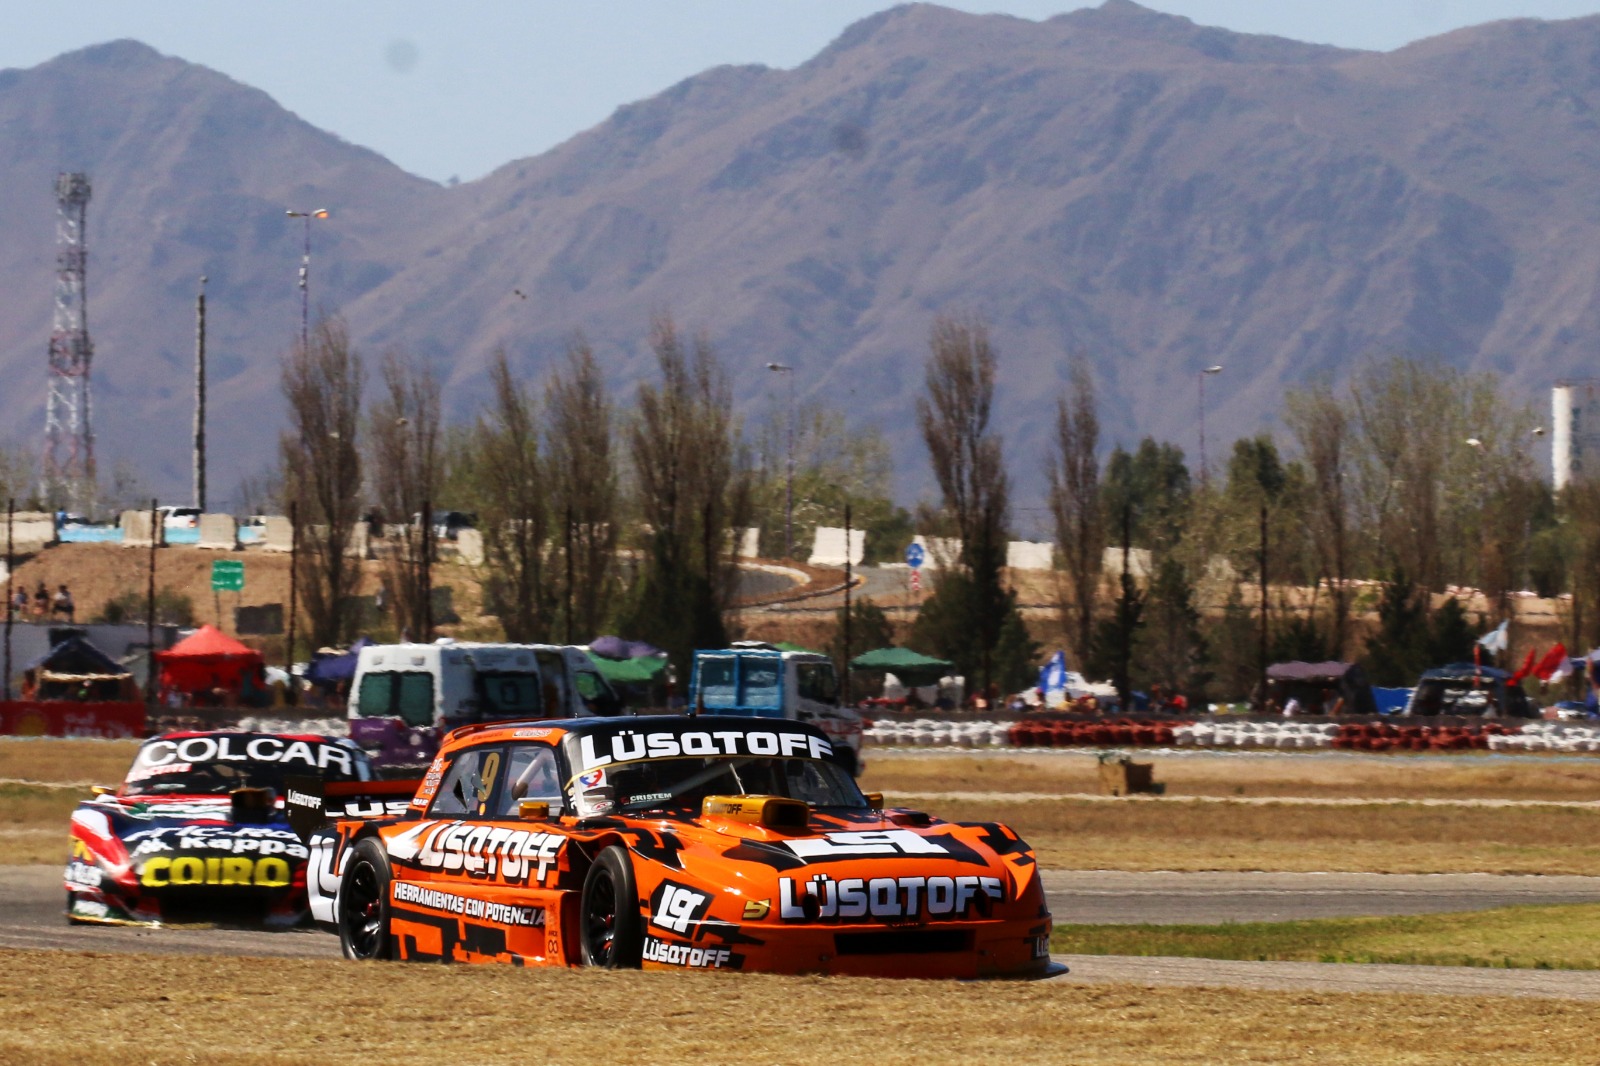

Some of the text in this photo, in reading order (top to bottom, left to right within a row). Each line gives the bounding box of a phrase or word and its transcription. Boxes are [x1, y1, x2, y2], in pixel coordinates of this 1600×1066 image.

[140, 737, 353, 775] COLCAR
[580, 730, 834, 769] LÜSQTOFF
[629, 792, 672, 802] CRISTEM
[179, 836, 309, 860] Kappa
[141, 856, 290, 887] COIRO
[394, 881, 546, 926] HERRAMIENTAS CON POTENCIA
[778, 874, 1004, 919] LÜSQTOFF
[642, 937, 731, 968] LÜSQTOFF
